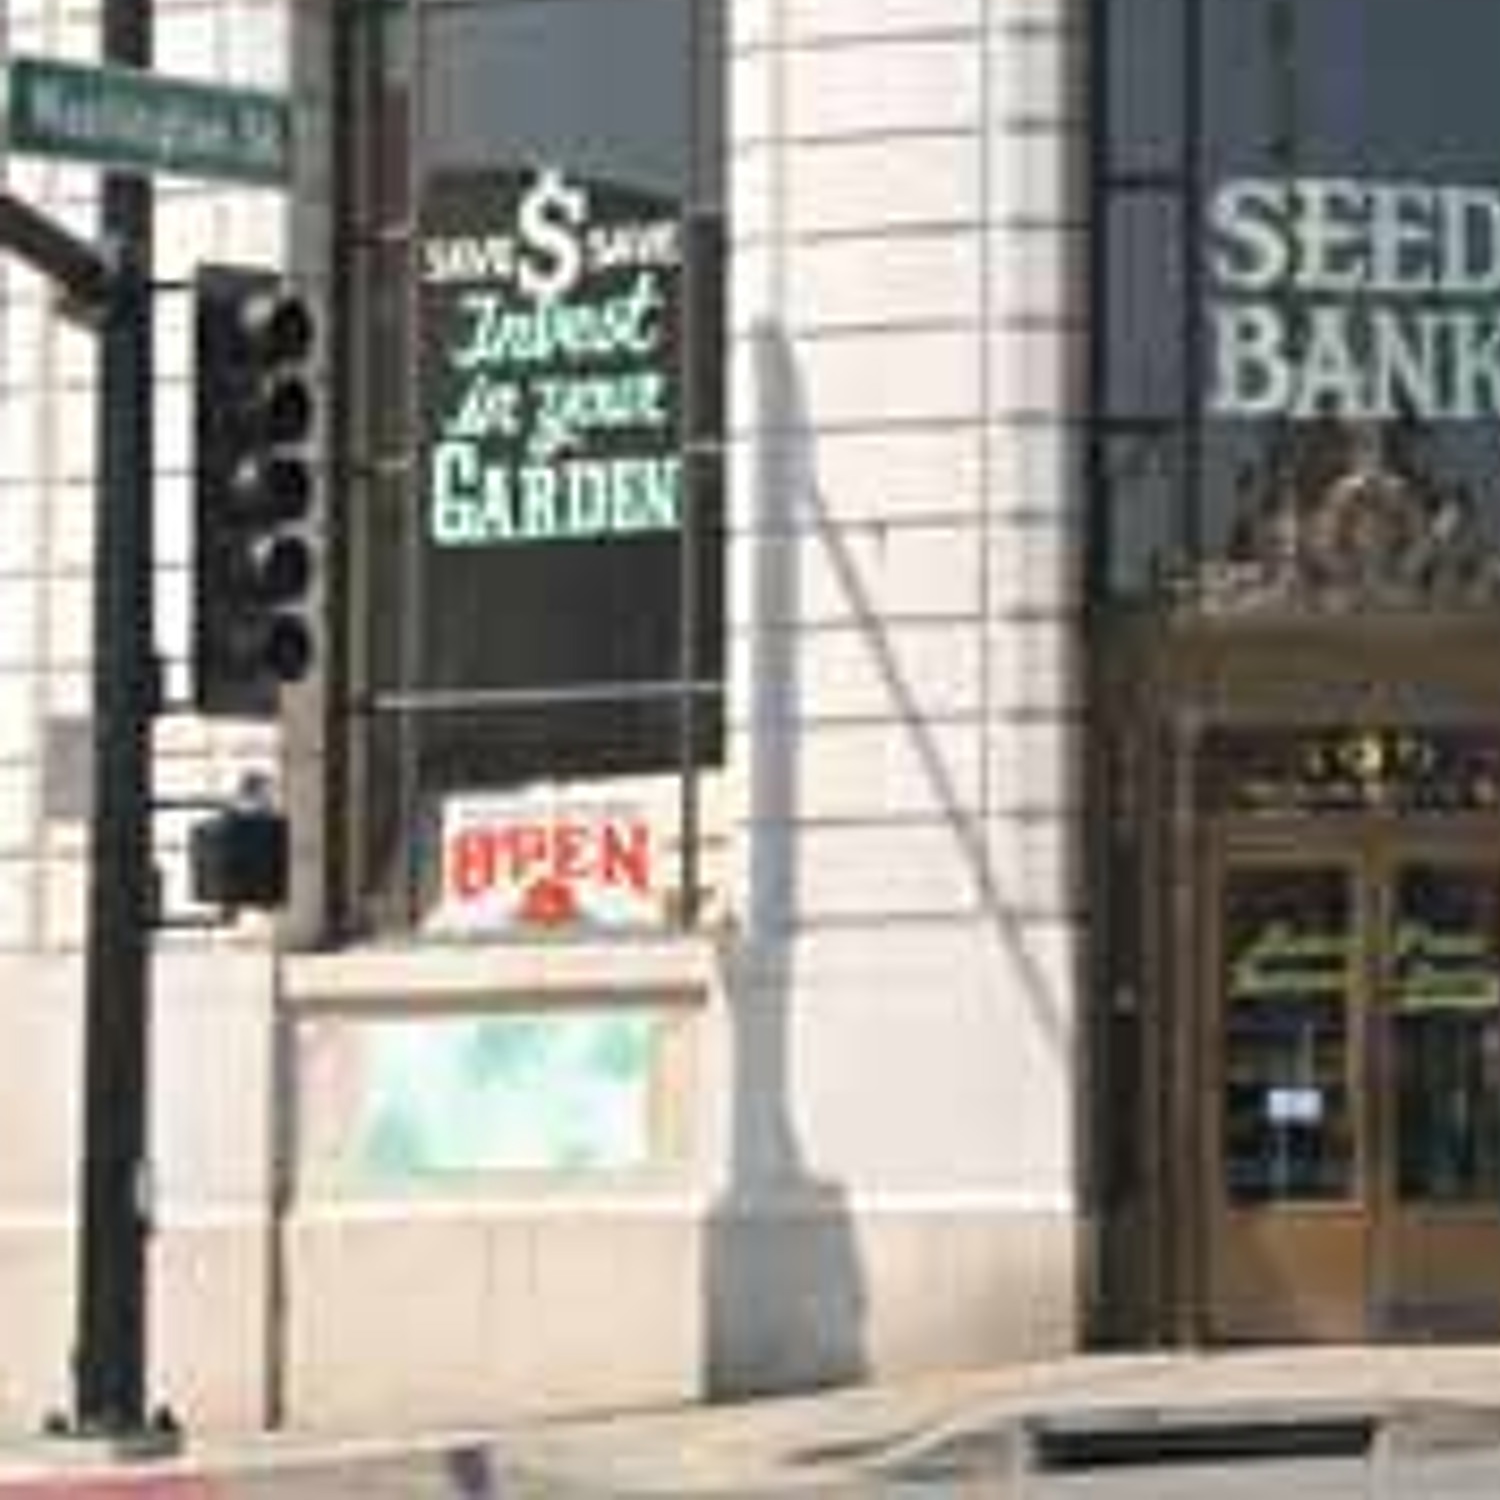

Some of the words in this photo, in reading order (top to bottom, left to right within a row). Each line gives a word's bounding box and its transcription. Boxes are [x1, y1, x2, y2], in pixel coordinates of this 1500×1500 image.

[452, 273, 664, 367] Invest
[444, 375, 522, 437] in
[530, 375, 666, 460] your
[433, 441, 682, 545] GARDEN
[455, 822, 652, 898] OPEN
